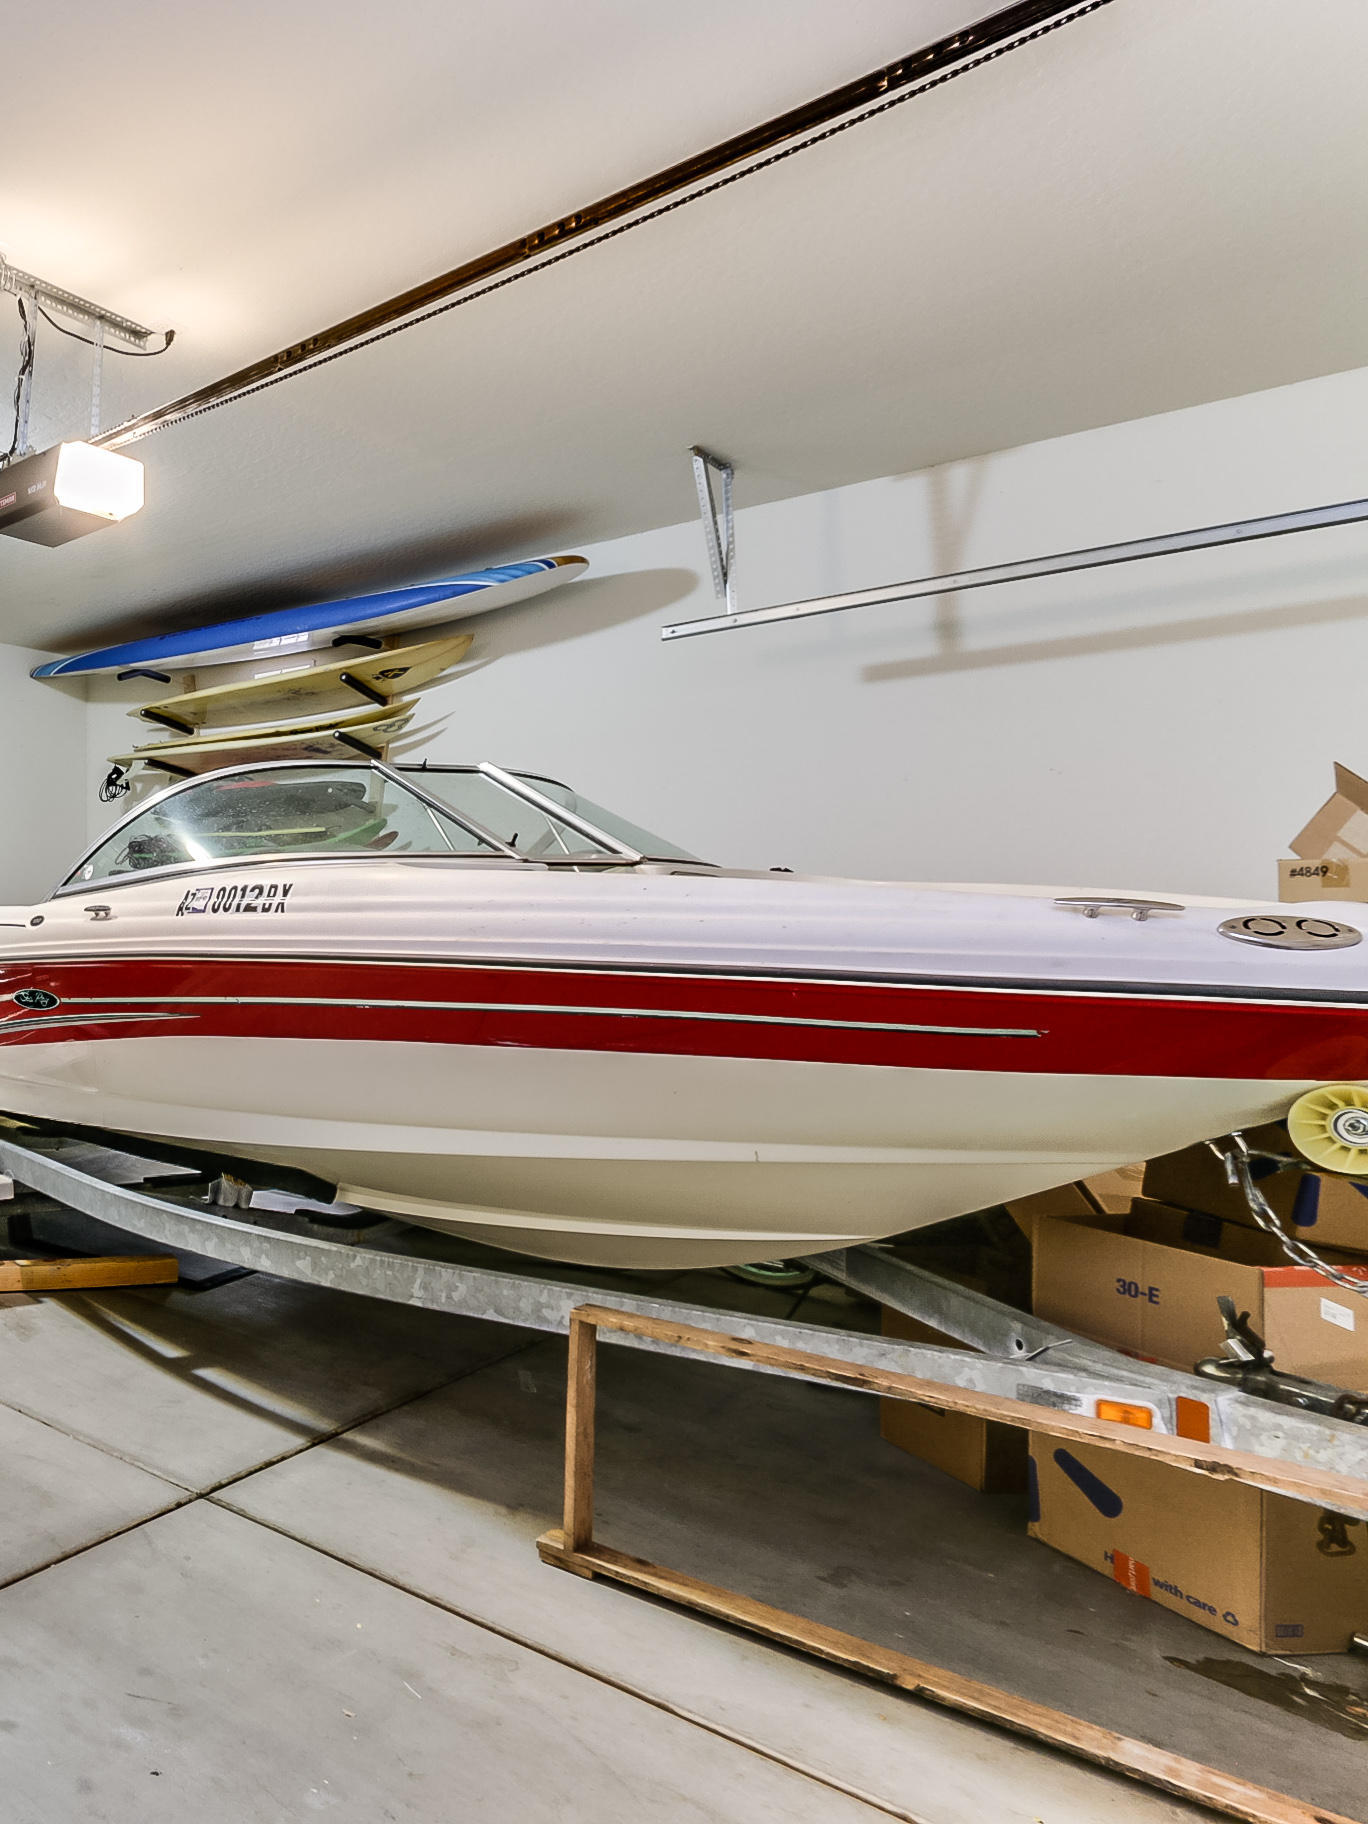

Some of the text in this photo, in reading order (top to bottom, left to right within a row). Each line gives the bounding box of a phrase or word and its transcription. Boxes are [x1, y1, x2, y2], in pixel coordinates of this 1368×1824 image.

[1289, 865, 1330, 878] #4849
[1115, 1277, 1161, 1305] 30-E
[1151, 1577, 1218, 1617] with care
